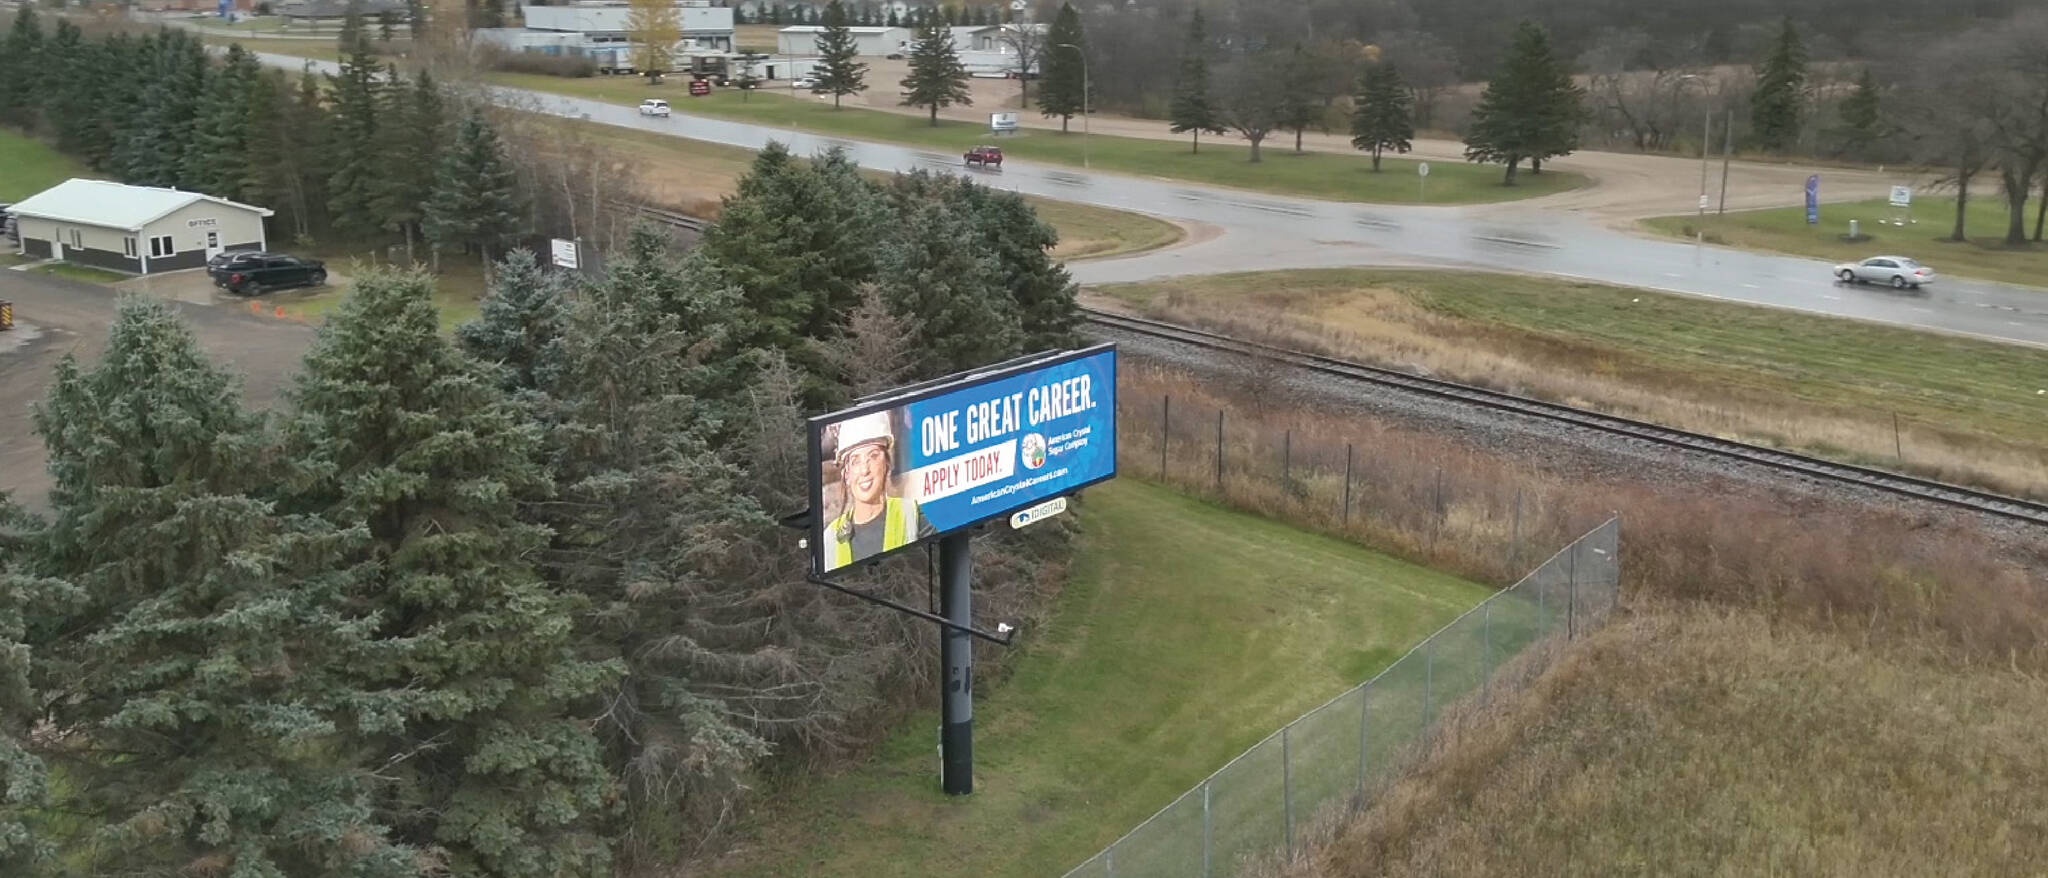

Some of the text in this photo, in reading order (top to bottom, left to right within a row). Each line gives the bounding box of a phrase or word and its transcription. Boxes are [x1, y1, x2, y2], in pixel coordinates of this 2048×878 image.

[921, 374, 1097, 457] ONE GREAT CAREER.
[923, 450, 1003, 496] APPLY TODAY.
